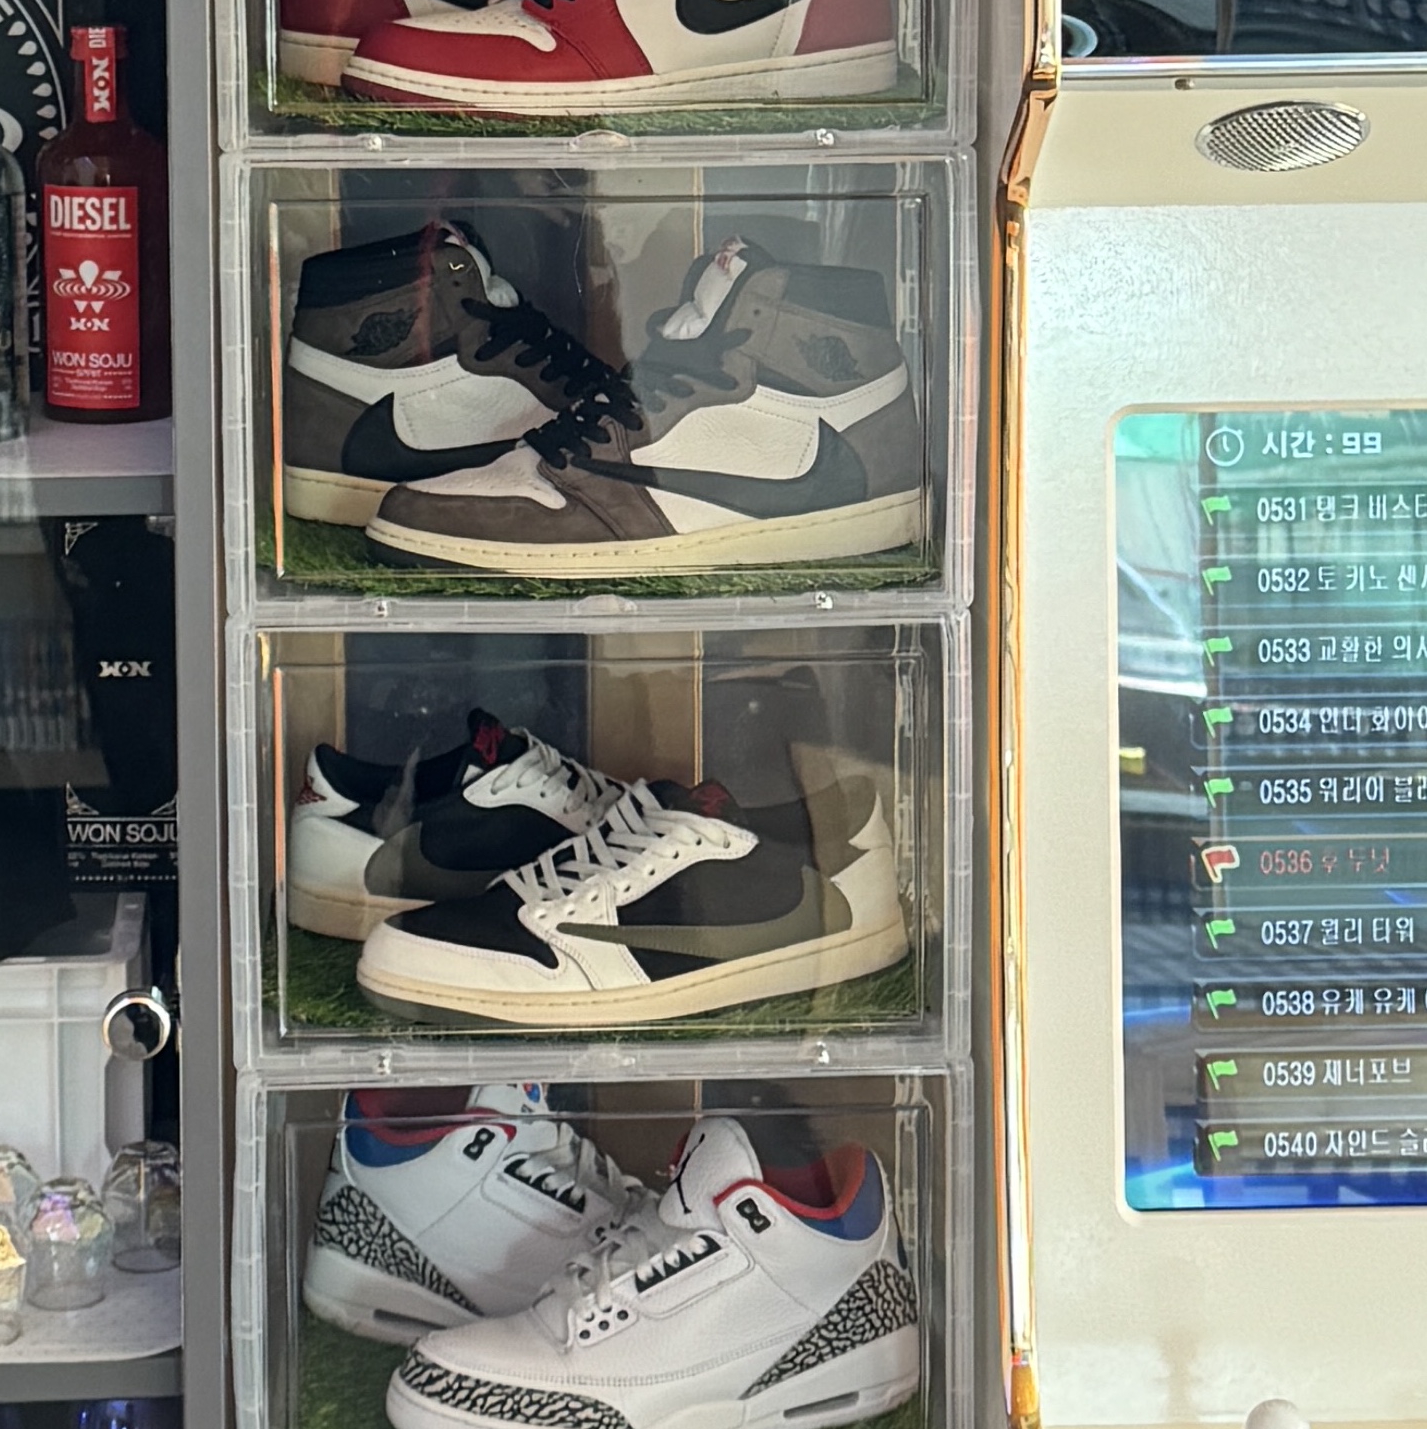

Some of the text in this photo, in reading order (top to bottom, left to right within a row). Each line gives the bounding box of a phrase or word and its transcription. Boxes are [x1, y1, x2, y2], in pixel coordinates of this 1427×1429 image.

[49, 194, 131, 231] DIESEL
[52, 350, 132, 368] WON SOJU
[1262, 429, 1316, 459] 시간
[1341, 432, 1382, 455] 99
[1256, 495, 1307, 522] 0531
[1257, 566, 1310, 593] 0532
[1257, 636, 1311, 664] 0533
[1259, 708, 1312, 735] 0534
[1259, 778, 1312, 806] 0535
[67, 823, 121, 843] WON
[1260, 849, 1313, 876] 0536
[1260, 919, 1314, 946] 0537
[1262, 990, 1315, 1016] 0538
[1263, 1061, 1316, 1088] 0539
[1264, 1132, 1317, 1158] 0540
